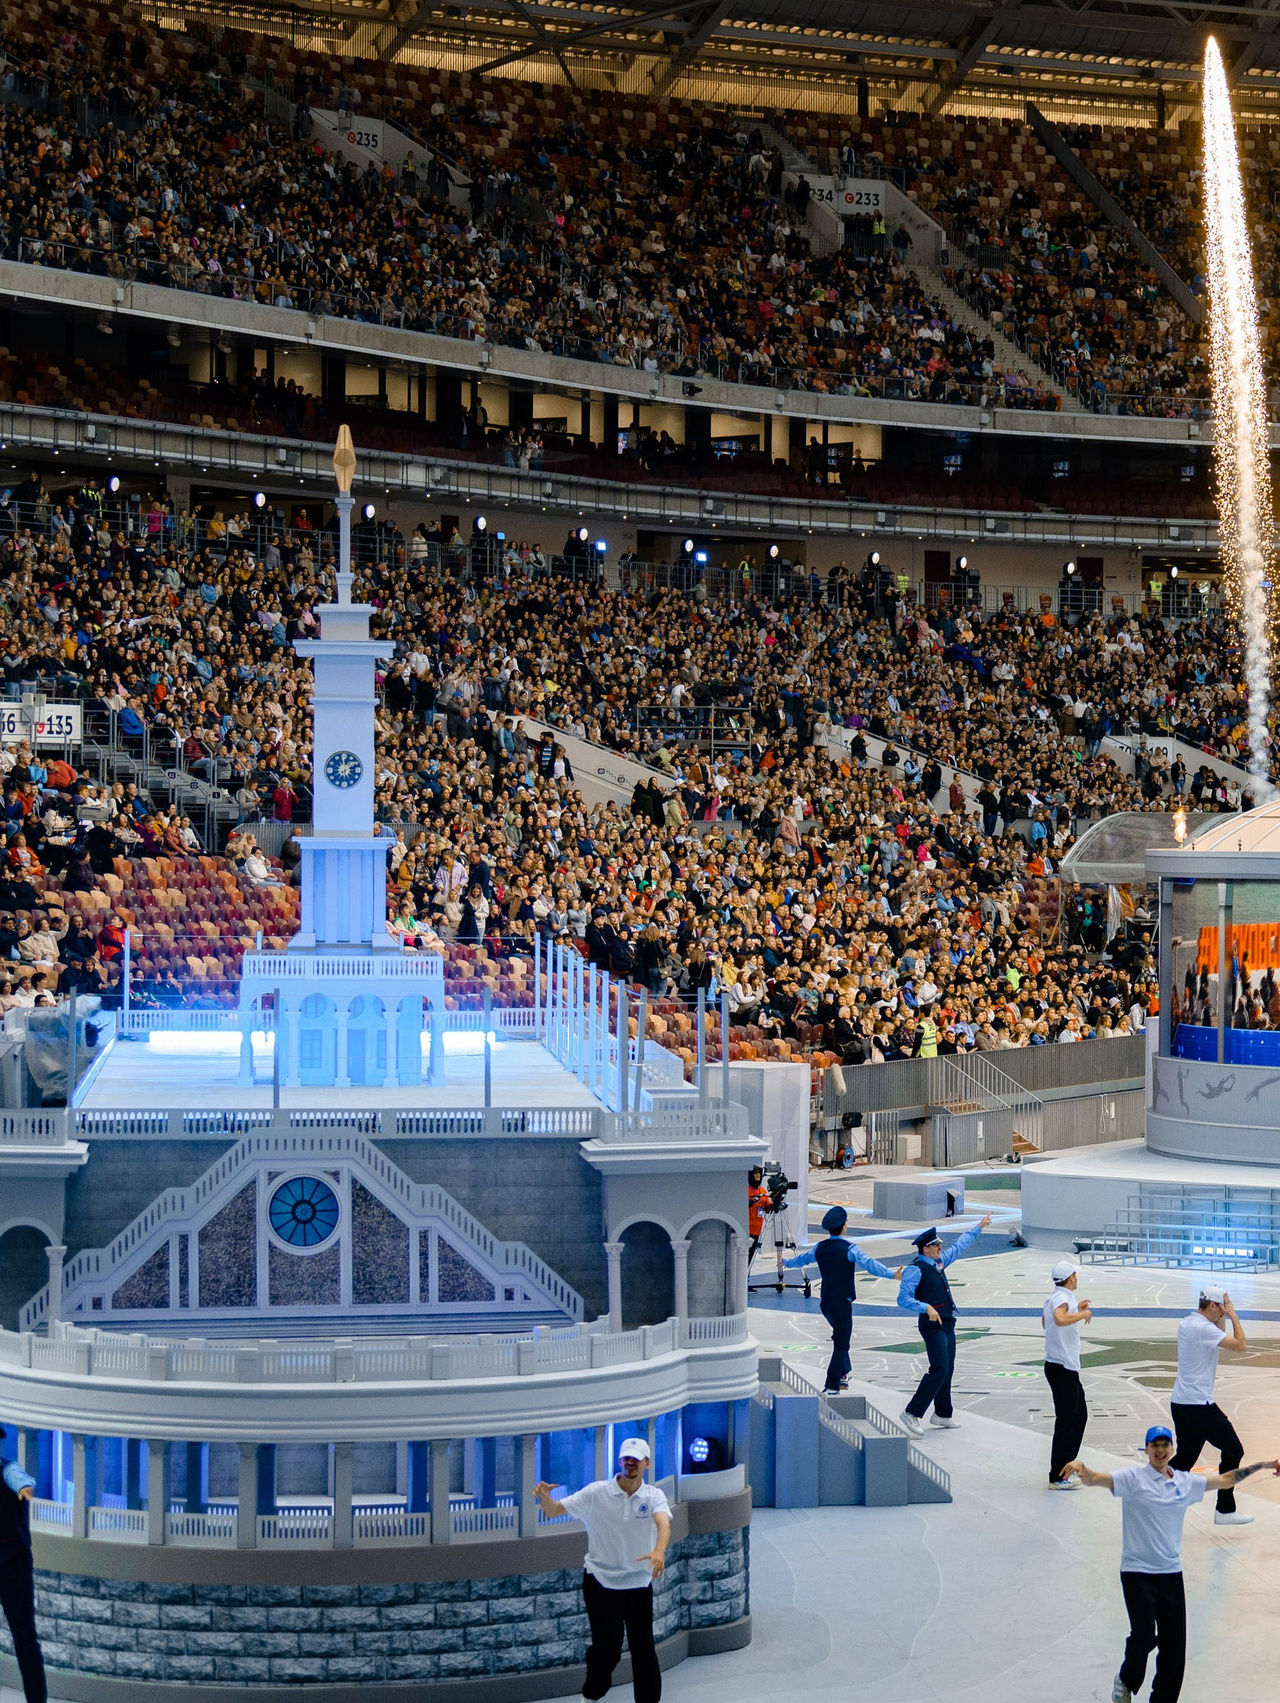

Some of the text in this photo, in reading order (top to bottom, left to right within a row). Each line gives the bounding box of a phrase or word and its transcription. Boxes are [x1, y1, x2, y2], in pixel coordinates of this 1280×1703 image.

[356, 131, 379, 148] 235
[855, 192, 880, 206] 233
[47, 714, 73, 736] 135
